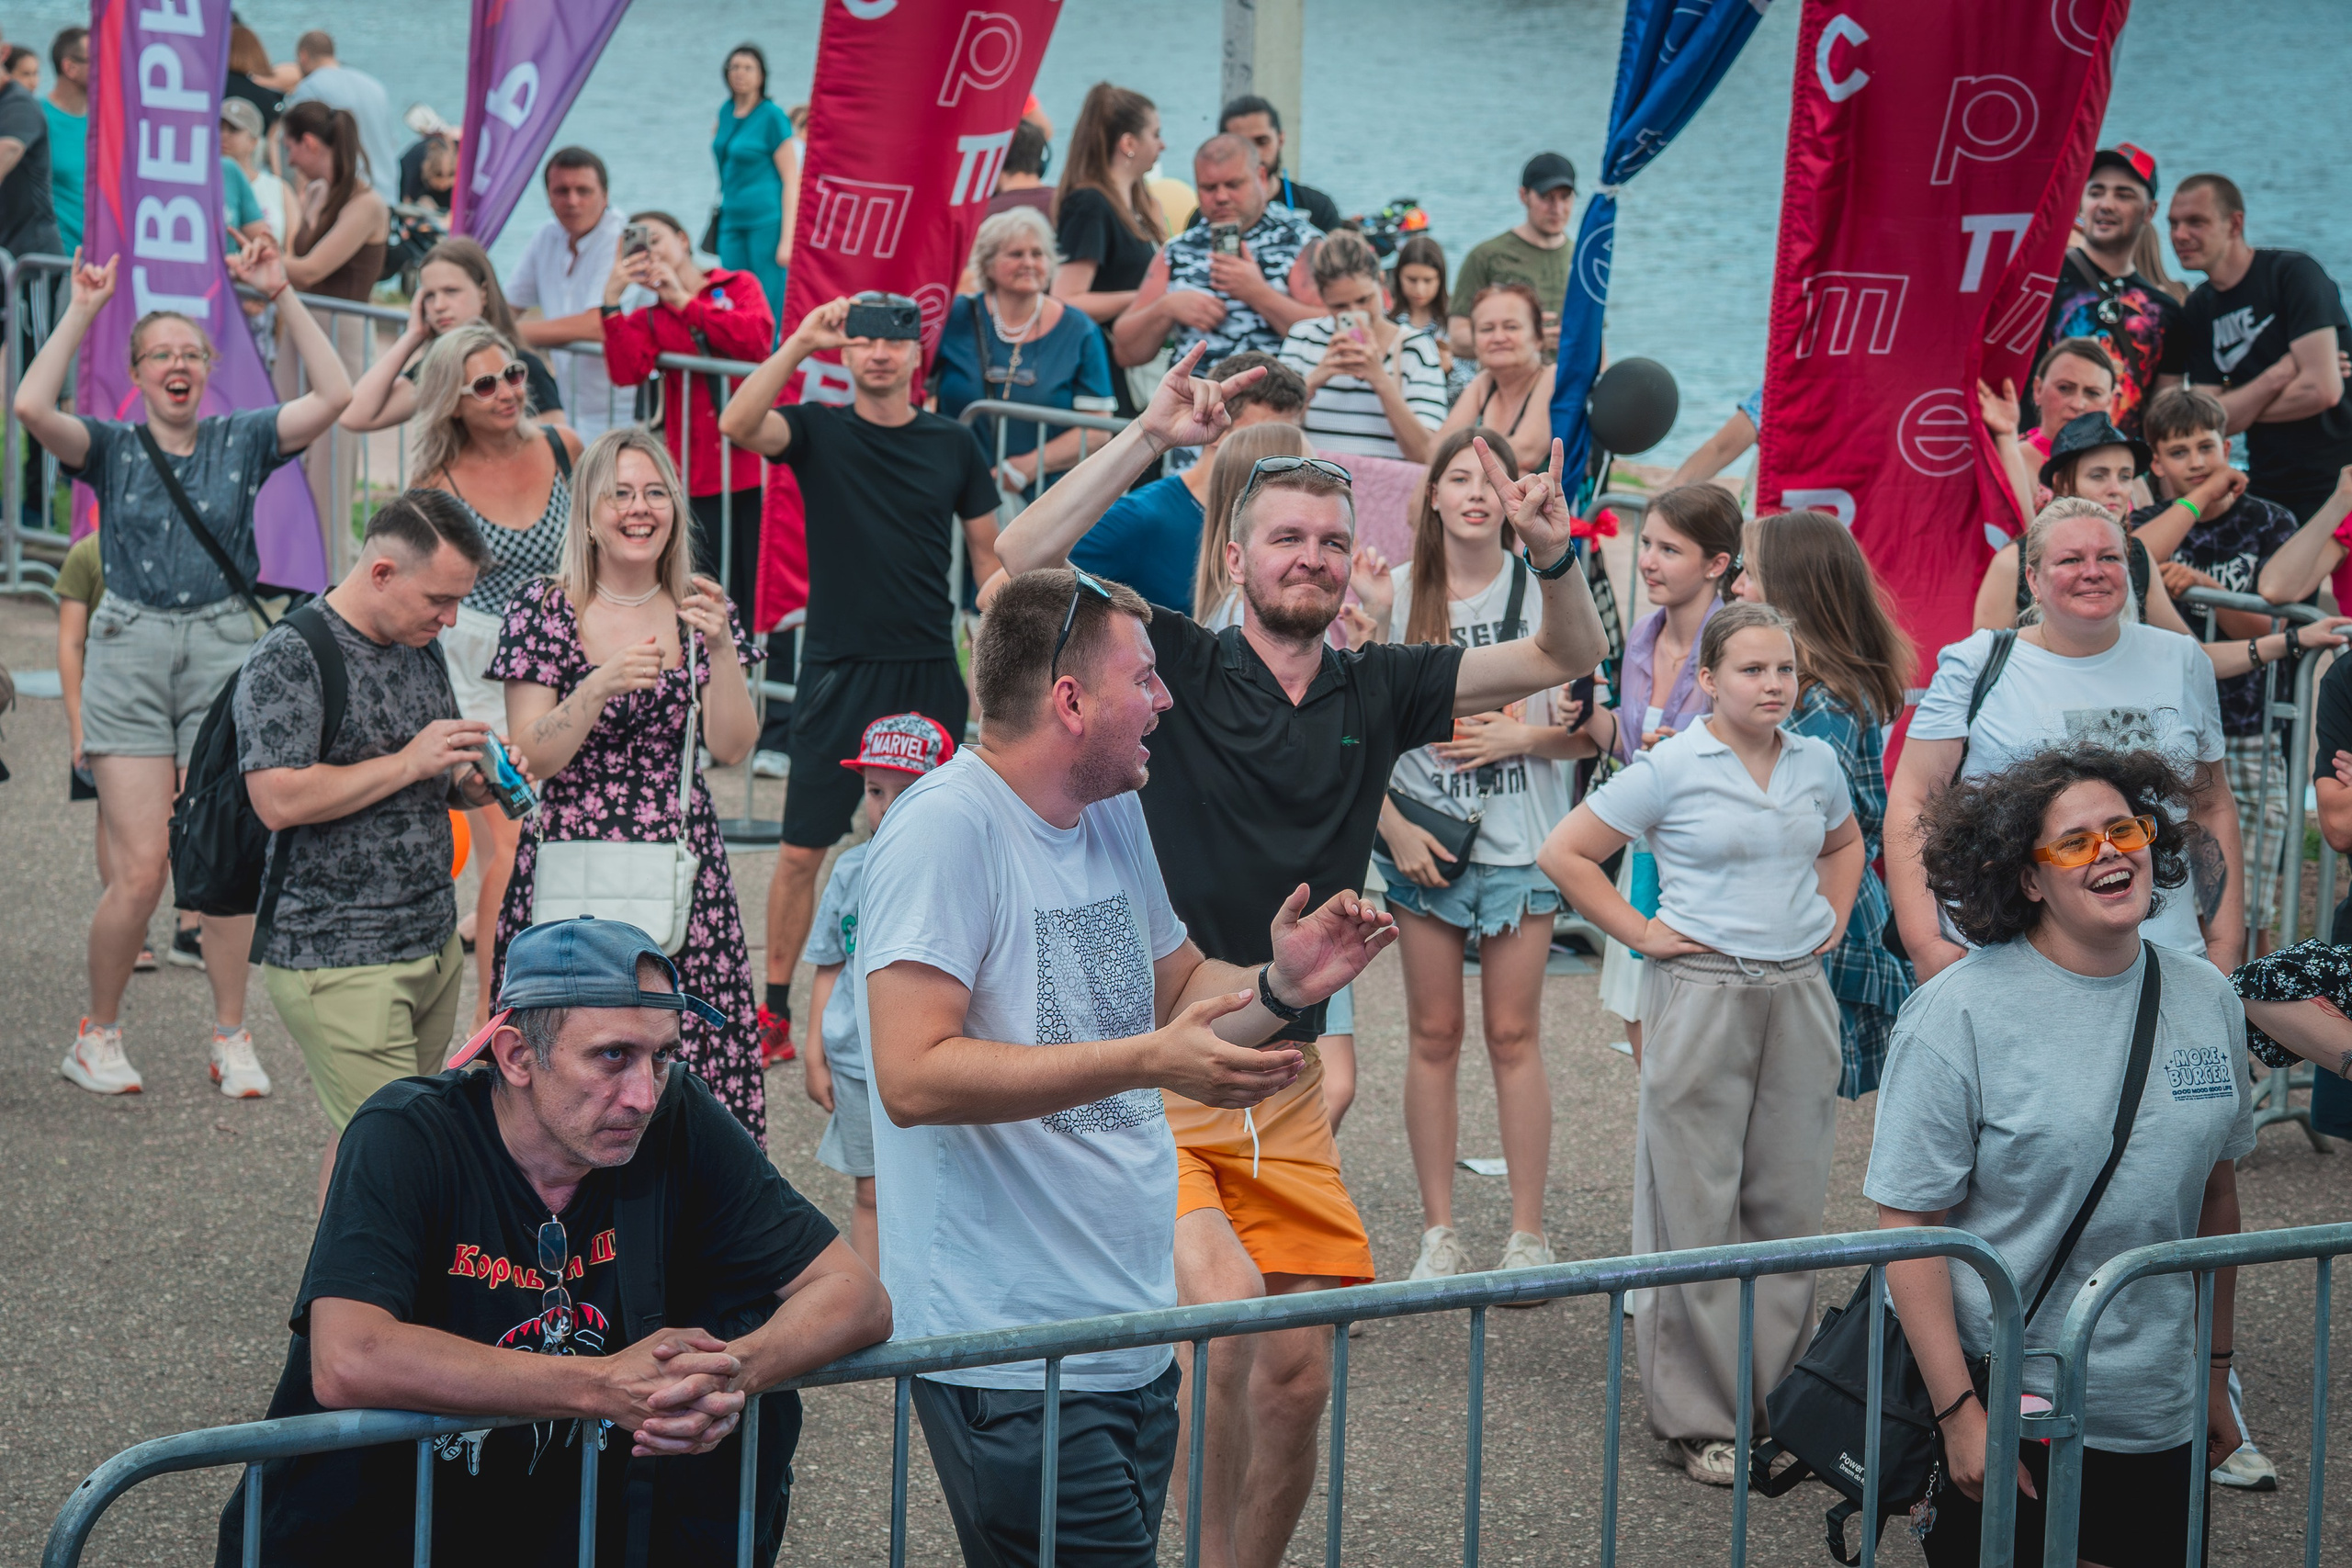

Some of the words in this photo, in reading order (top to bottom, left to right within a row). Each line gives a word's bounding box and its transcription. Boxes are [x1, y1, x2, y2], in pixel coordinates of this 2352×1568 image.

[2212, 305, 2256, 349] NIKE
[872, 733, 925, 761] MARVEL
[2174, 1046, 2220, 1067] MORE
[2167, 1065, 2231, 1088] BURGER
[448, 1244, 545, 1290] Король
[1839, 1451, 1865, 1473] Power
